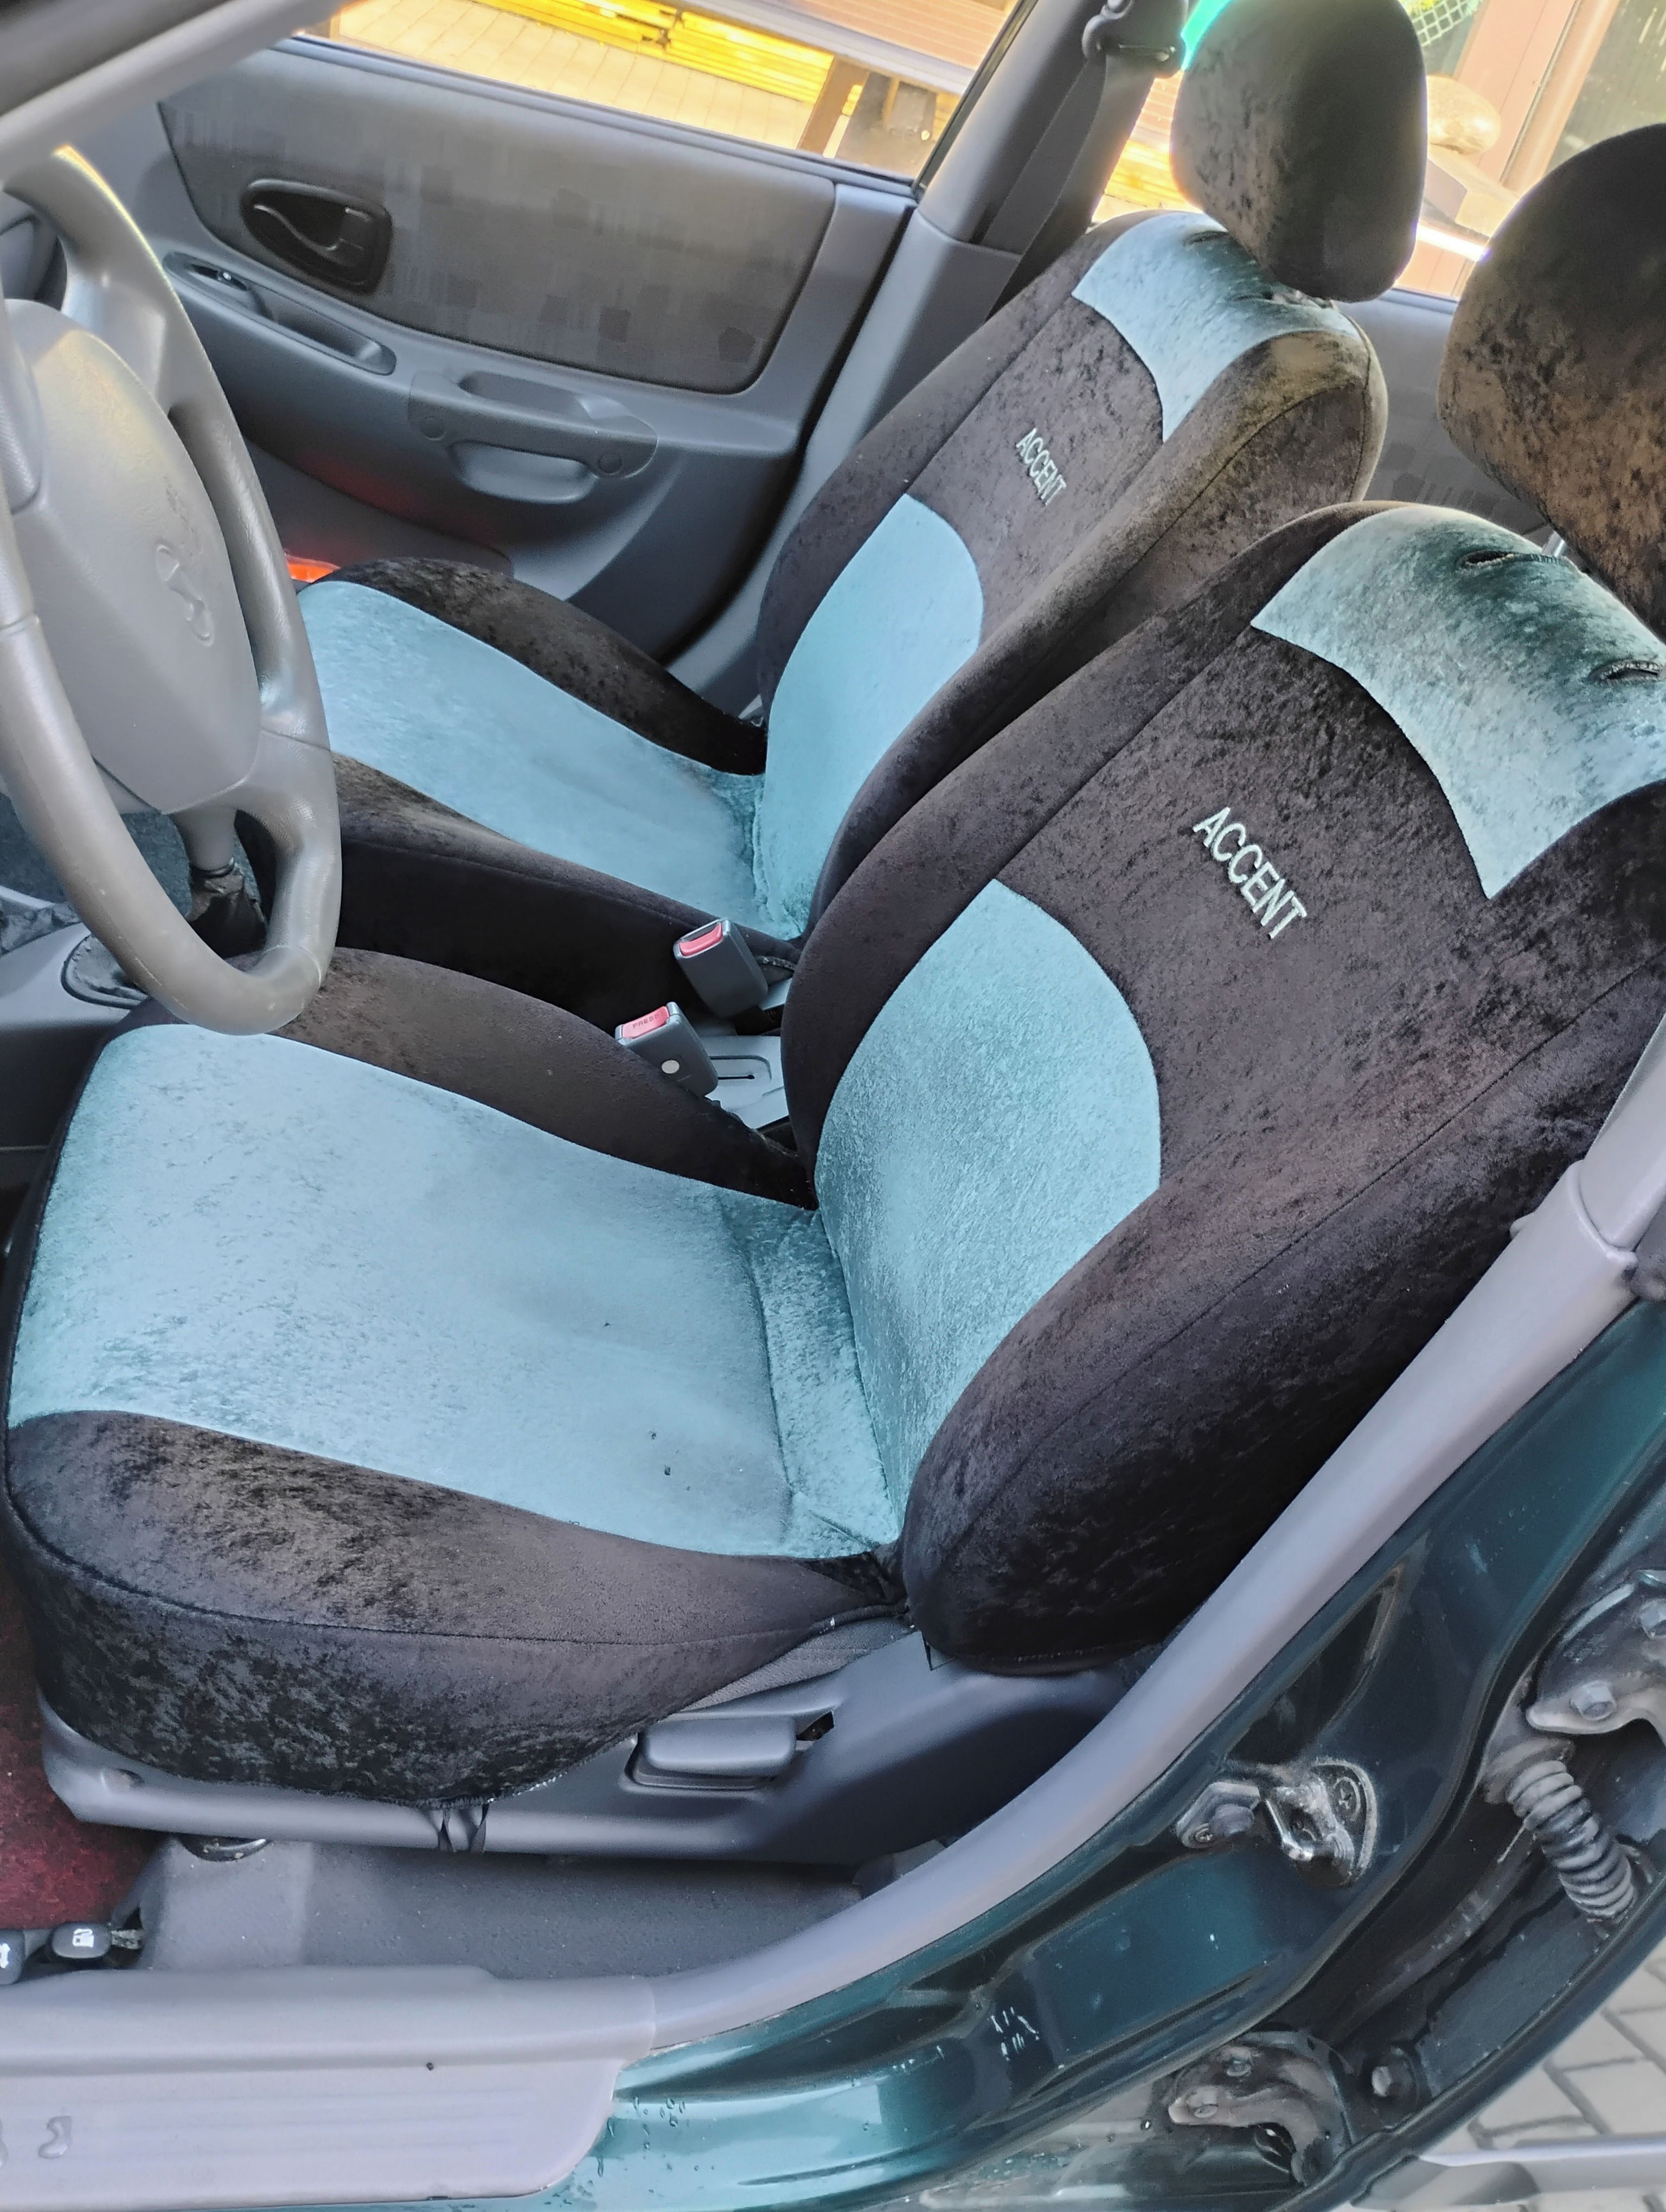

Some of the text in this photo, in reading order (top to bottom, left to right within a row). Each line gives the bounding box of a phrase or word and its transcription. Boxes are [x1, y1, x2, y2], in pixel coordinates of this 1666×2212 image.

[1016, 427, 1067, 506] ACCENT
[1193, 807, 1307, 939] ACCENT
[632, 1012, 660, 1028] PRESS
